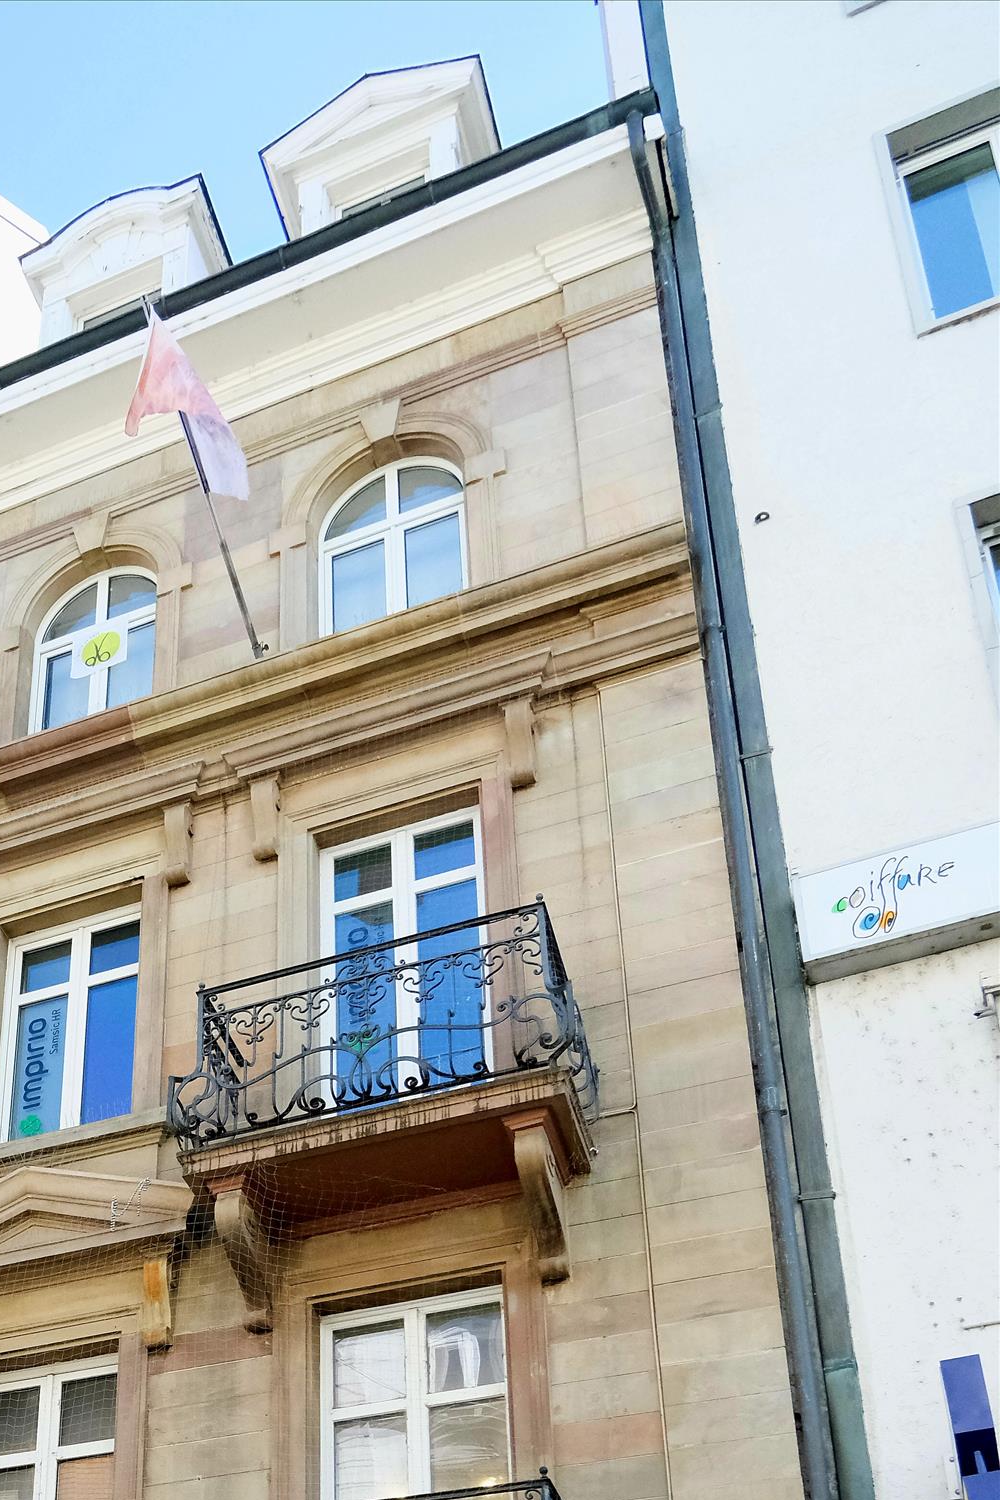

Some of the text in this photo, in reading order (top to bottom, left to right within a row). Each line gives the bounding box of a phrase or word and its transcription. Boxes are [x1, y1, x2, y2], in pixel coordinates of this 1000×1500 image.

[22, 1017, 49, 1110] impirio
[49, 1008, 61, 1055] Samsic HR
